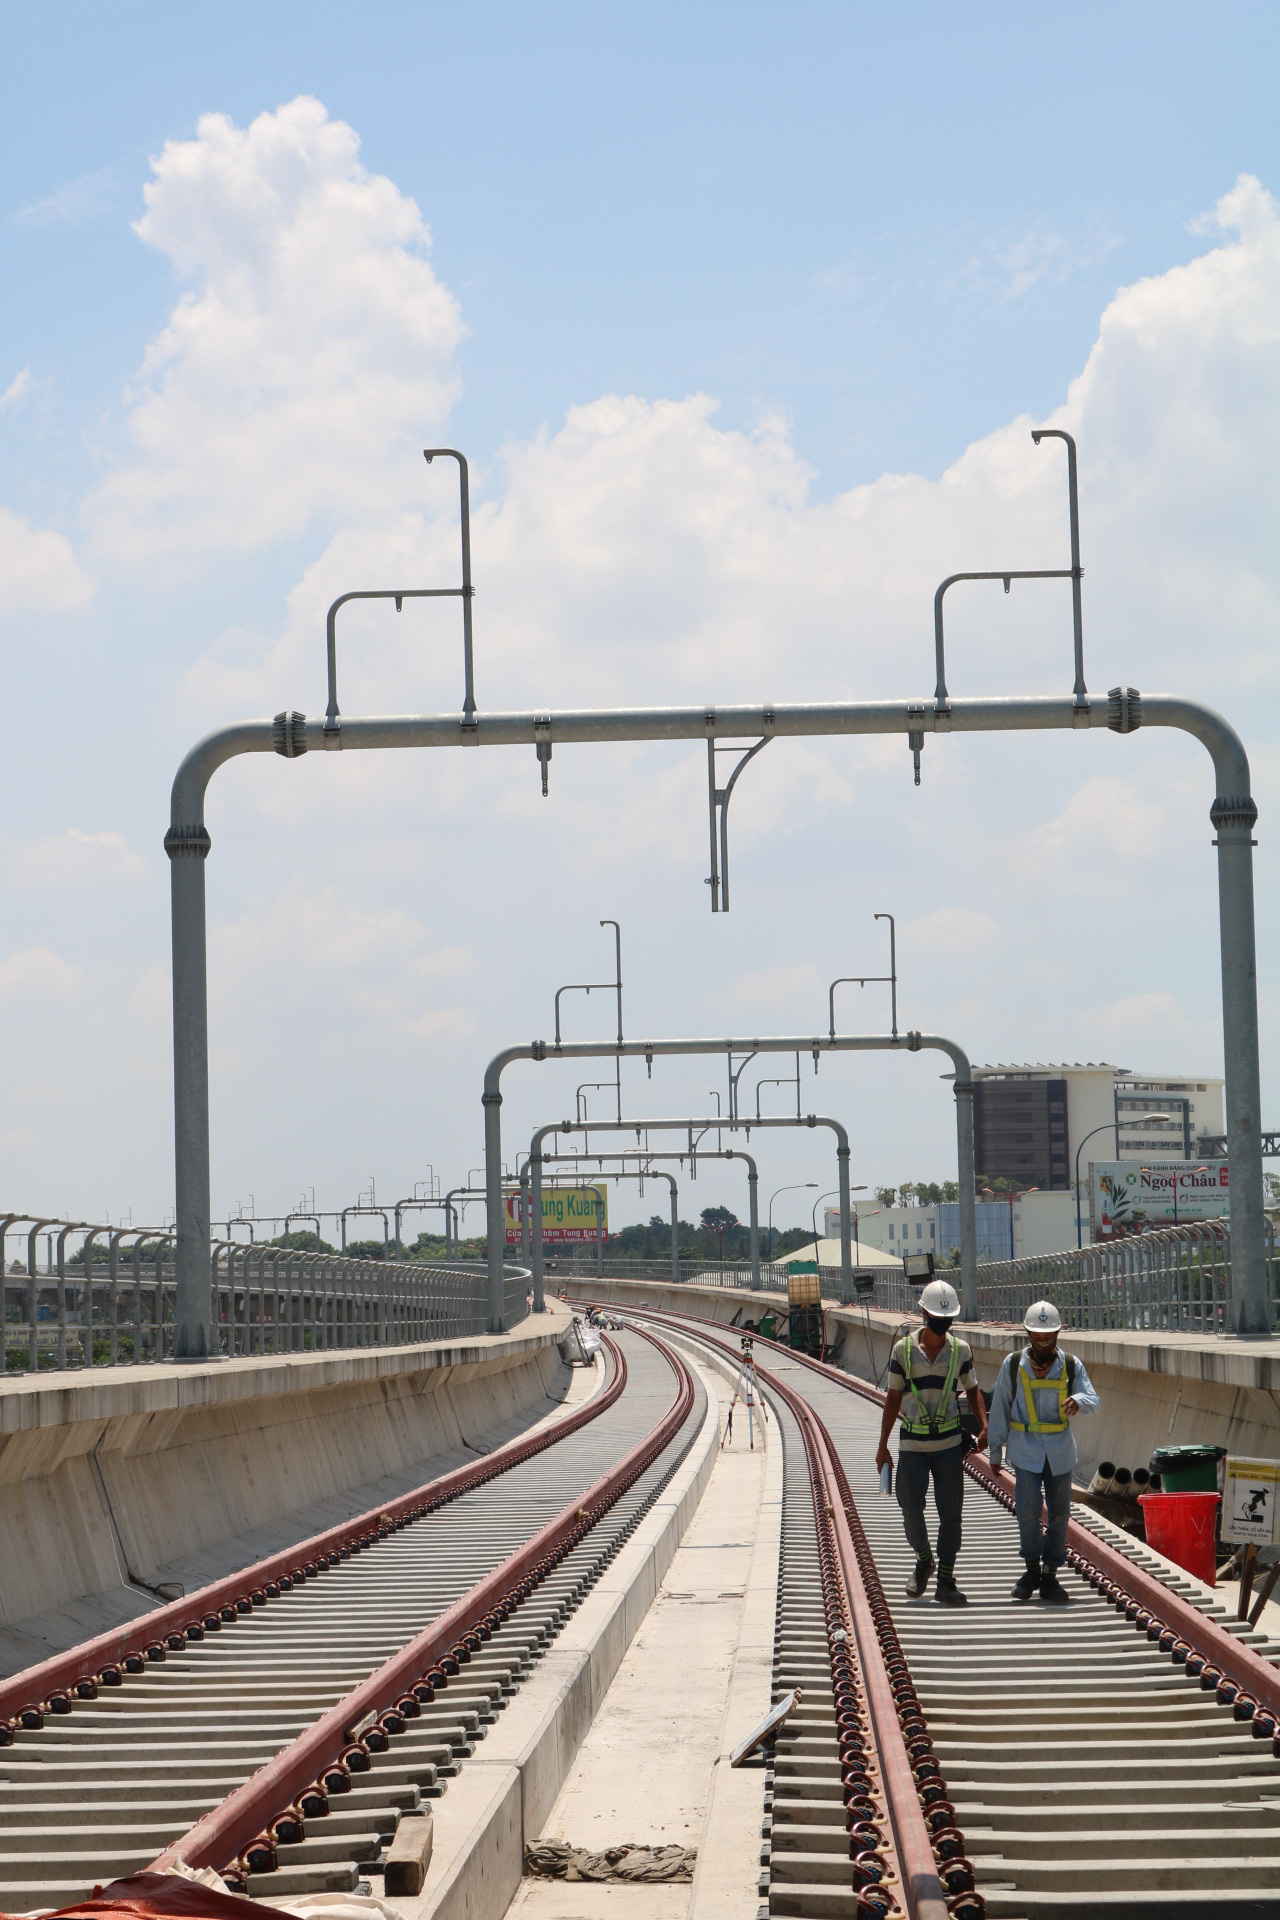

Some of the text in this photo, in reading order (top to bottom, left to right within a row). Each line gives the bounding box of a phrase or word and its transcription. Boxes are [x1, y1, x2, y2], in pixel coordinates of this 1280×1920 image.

[1140, 1174, 1176, 1191] Ngọc
[1179, 1173, 1217, 1187] Châu
[539, 1197, 563, 1222] ung
[541, 1229, 560, 1237] hôm
[583, 1229, 606, 1238] Kuag
